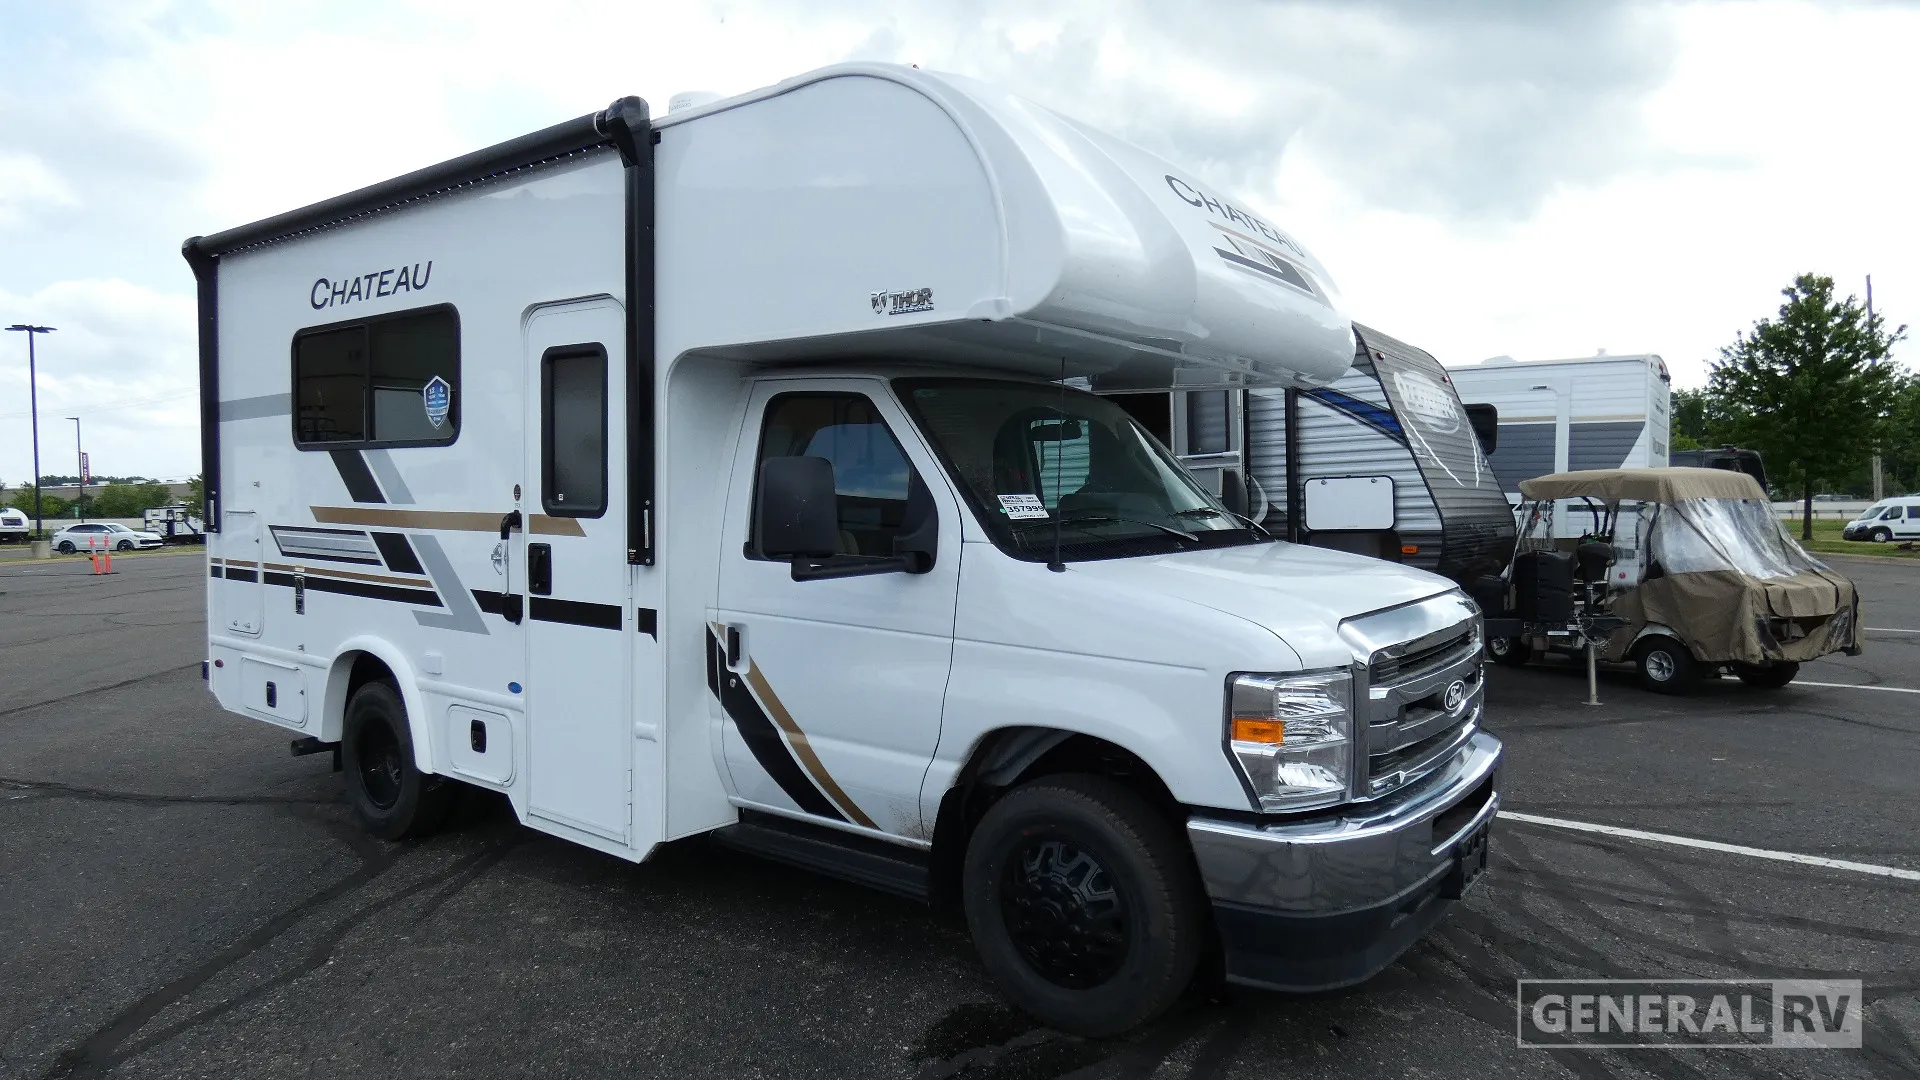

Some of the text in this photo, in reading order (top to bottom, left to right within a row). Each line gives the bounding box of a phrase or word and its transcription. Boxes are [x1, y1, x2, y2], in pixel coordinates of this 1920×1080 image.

[1164, 174, 1306, 258] CHATEAU
[310, 260, 433, 310] CHATEAU
[888, 287, 934, 310] THOR
[1448, 684, 1463, 707] Ford
